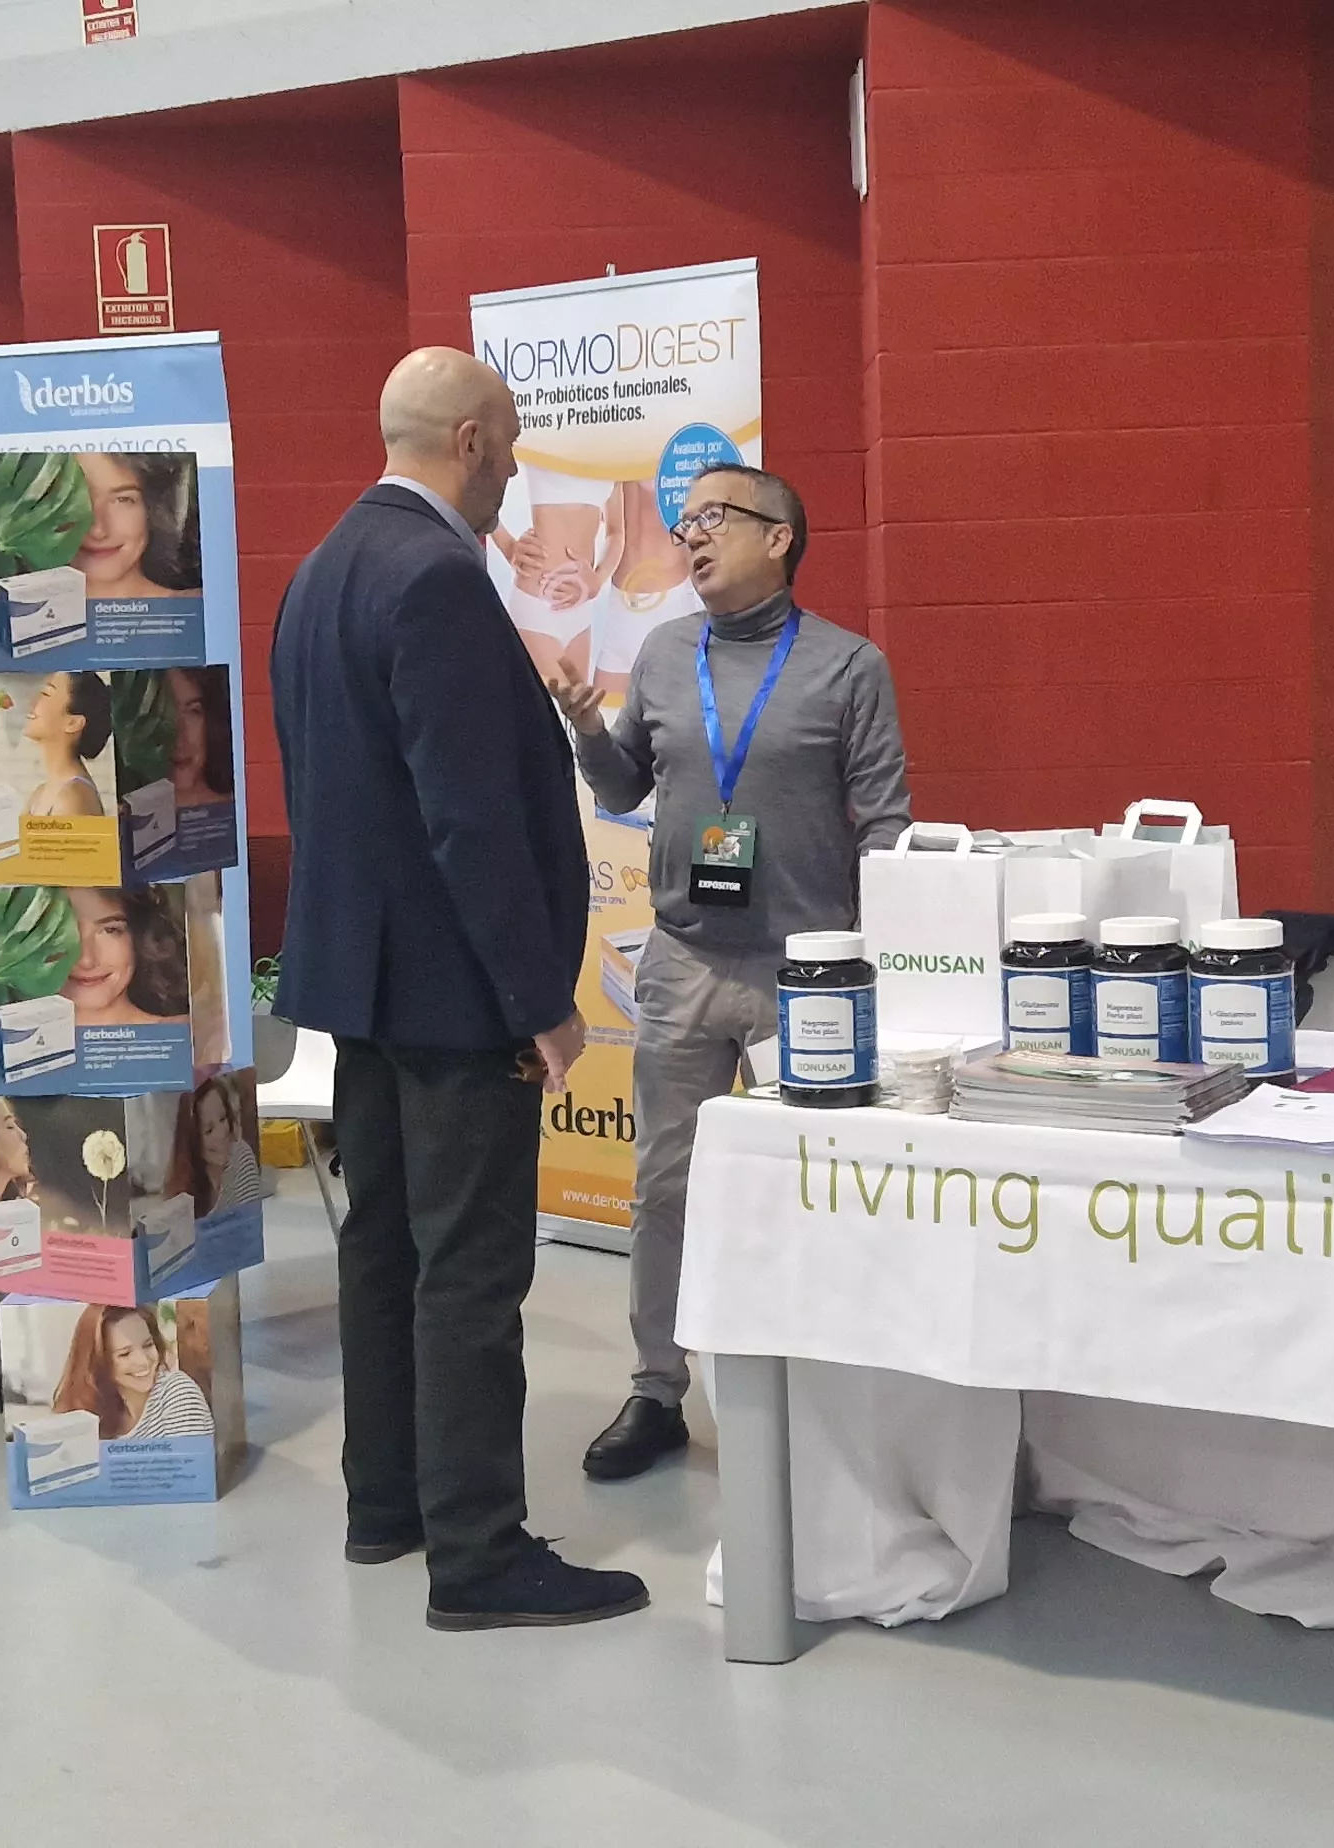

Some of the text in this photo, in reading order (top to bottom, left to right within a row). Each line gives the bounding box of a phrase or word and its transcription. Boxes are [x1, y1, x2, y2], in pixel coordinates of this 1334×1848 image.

[105, 301, 166, 313] EXTINTOR DE
[110, 314, 162, 326] INCENDIOS
[34, 372, 134, 408] derbós
[536, 381, 609, 407] Probióticos
[613, 375, 692, 398] funcionales,
[556, 411, 564, 431] y
[567, 404, 646, 427] Prebióticos.
[707, 441, 724, 455] por
[94, 601, 149, 613] derboskin
[879, 952, 985, 974] BONUSAN
[83, 1028, 136, 1040] derboskin
[798, 1134, 1040, 1254] living
